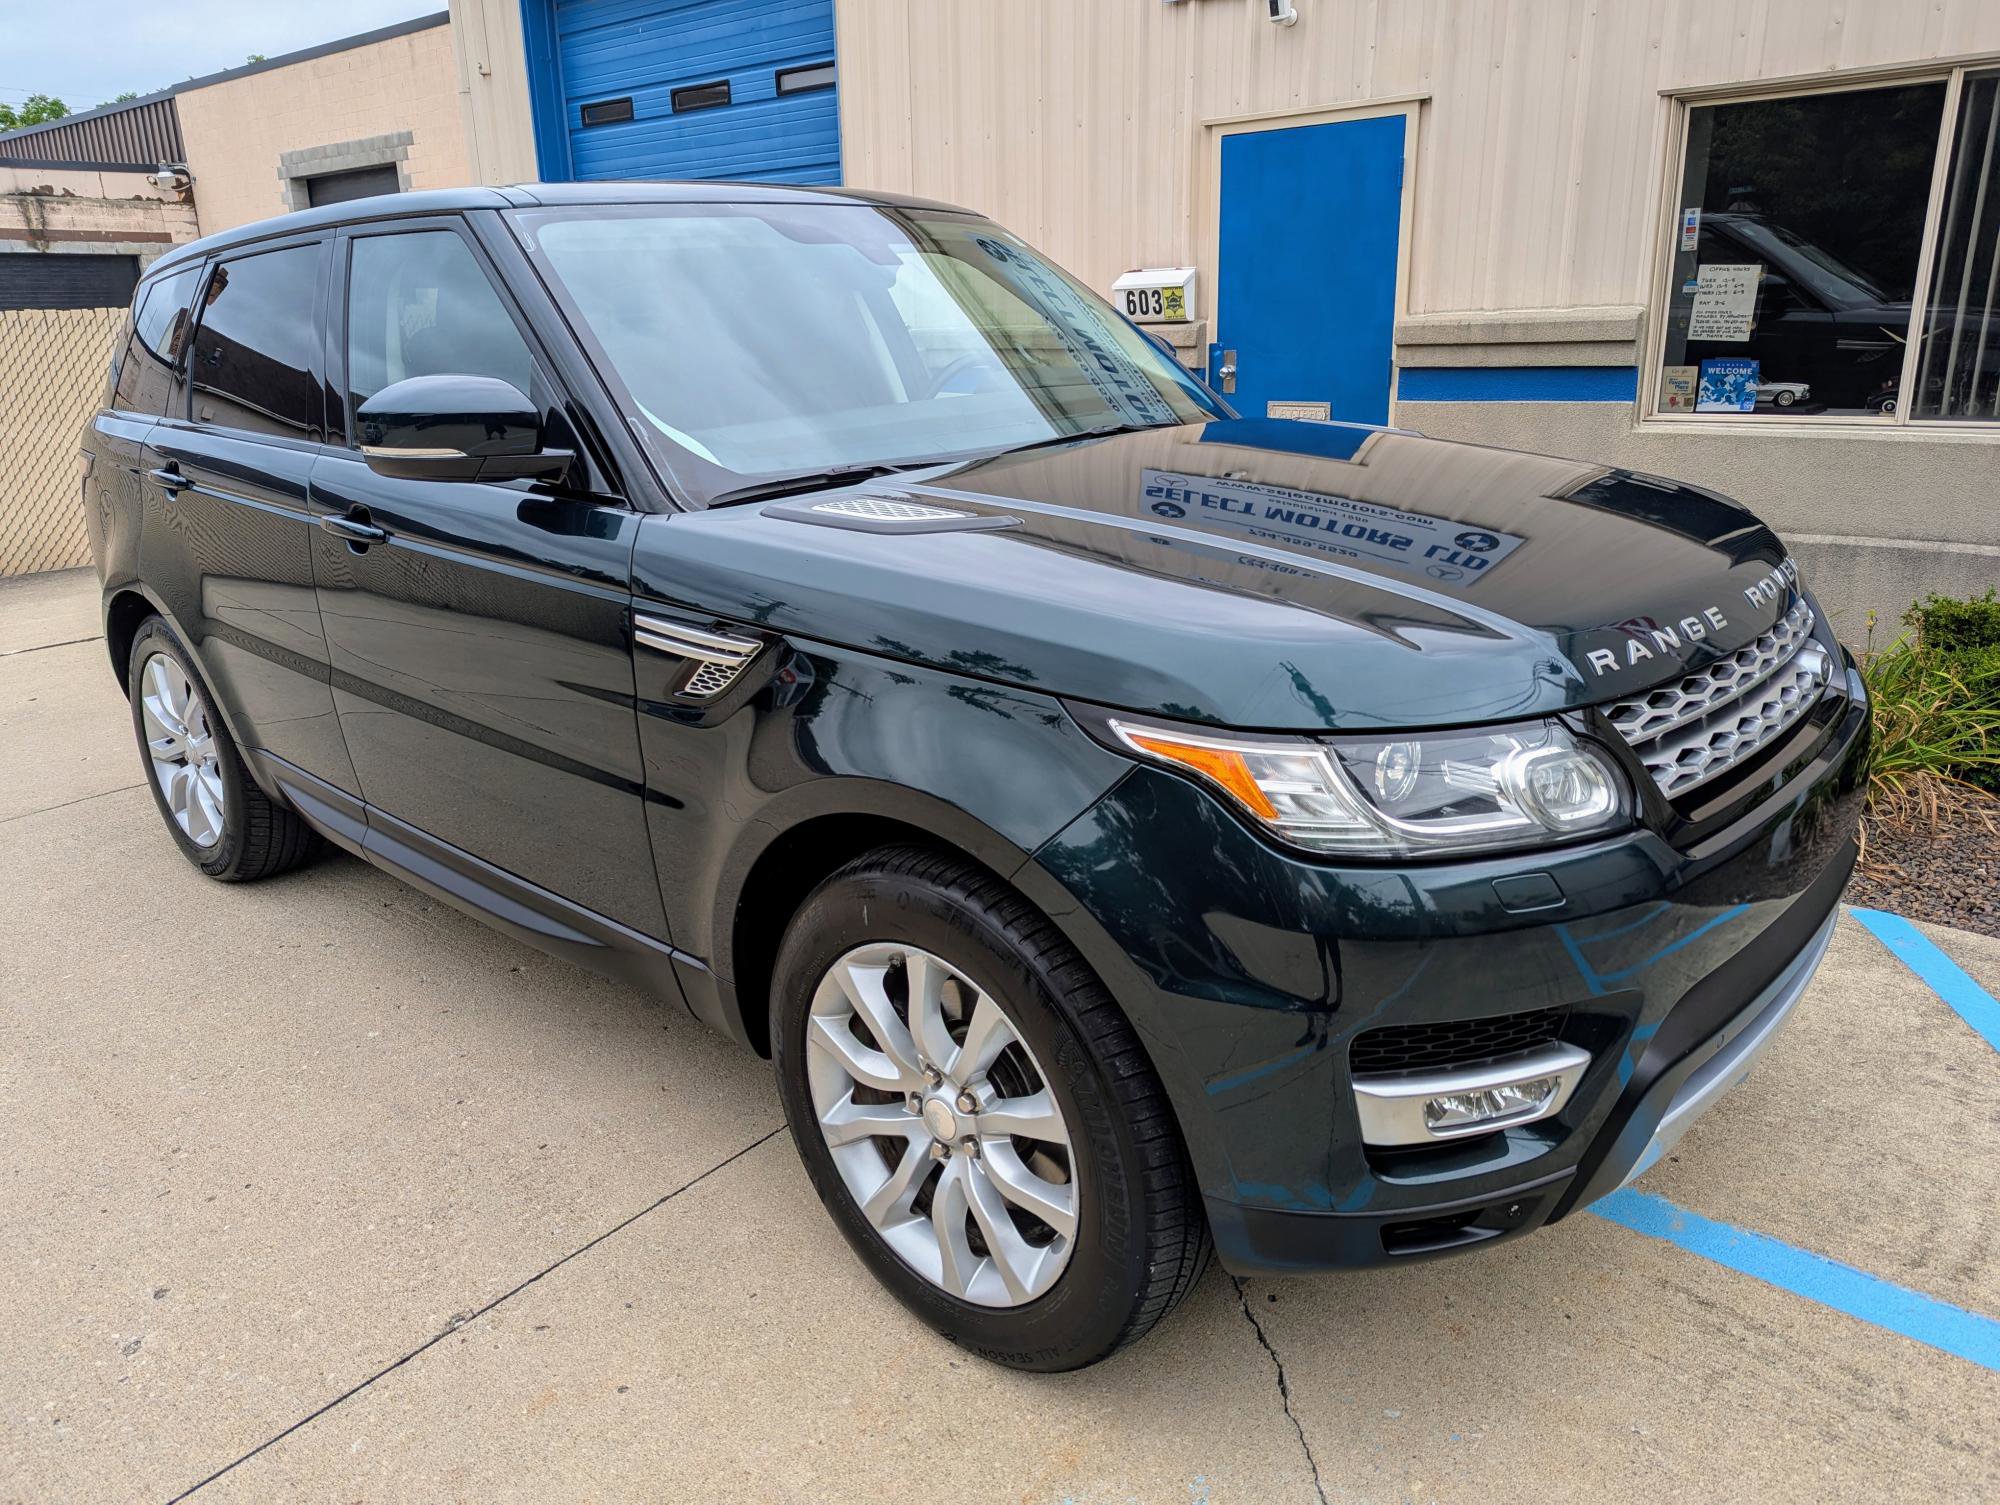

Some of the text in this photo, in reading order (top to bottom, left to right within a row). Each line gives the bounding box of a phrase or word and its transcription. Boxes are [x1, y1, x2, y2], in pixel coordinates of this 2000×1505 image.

[1125, 289, 1163, 316] 603
[1707, 367, 1753, 375] WELCOME
[1584, 557, 1799, 676] RANGE ROVE
[978, 1348, 1034, 1364] SEASON
